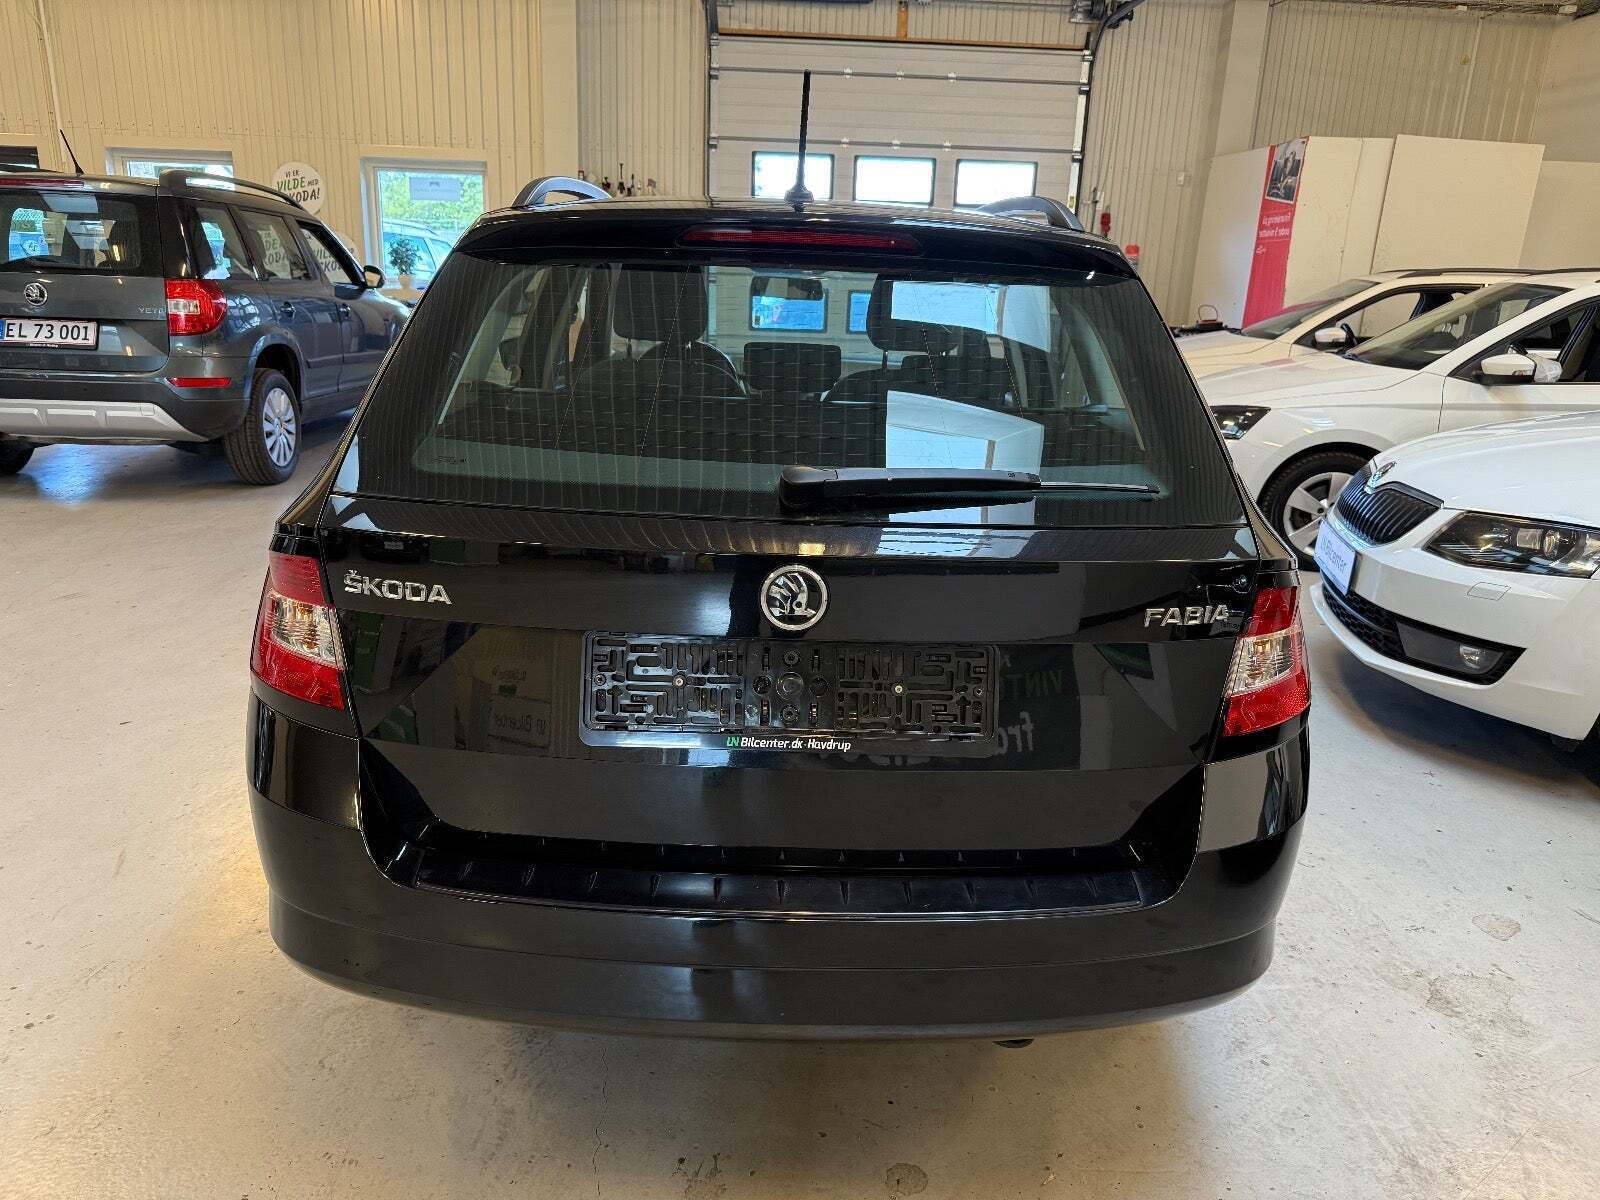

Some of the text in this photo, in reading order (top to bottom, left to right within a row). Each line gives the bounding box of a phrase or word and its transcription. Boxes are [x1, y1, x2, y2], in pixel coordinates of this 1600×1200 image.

[277, 177, 305, 192] VILDE
[289, 187, 320, 203] KODA!
[5, 322, 90, 342] EL 73 001
[343, 568, 453, 605] ŠKODA
[1144, 604, 1229, 628] FABIA
